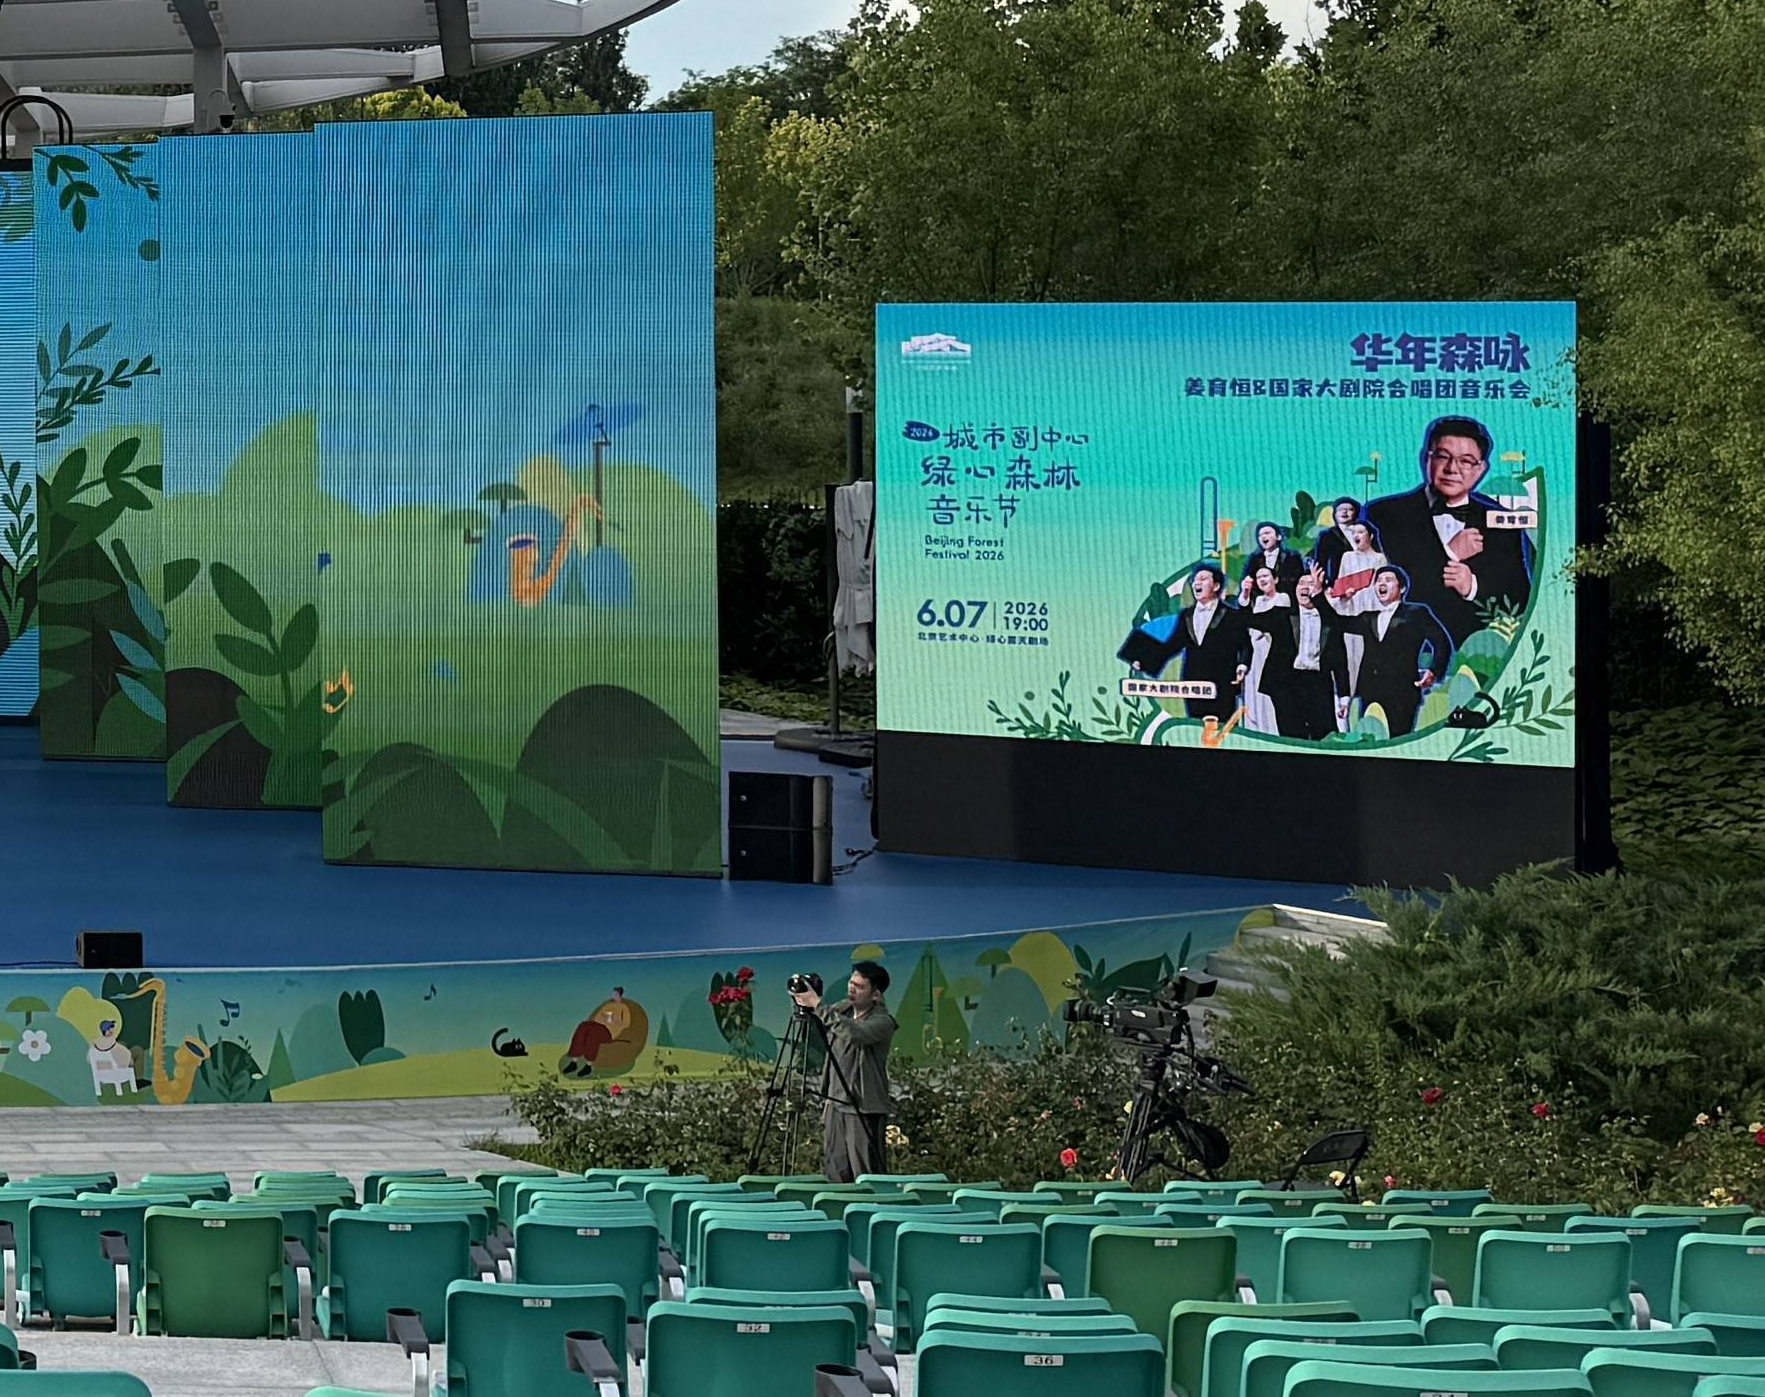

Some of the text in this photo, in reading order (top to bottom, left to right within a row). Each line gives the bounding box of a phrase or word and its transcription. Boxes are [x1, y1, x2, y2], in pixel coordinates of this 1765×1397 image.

[1349, 331, 1533, 373] 华年森咏
[942, 421, 1090, 453] 城市副中心
[920, 453, 1082, 492] 绿心森林
[925, 492, 1023, 529] 音乐节
[924, 534, 1005, 549] Beijing Forest
[924, 548, 1005, 561] Festival 2026
[916, 598, 989, 629] 6.07
[1003, 616, 1049, 631] 19:00
[1004, 601, 1049, 616] 2026
